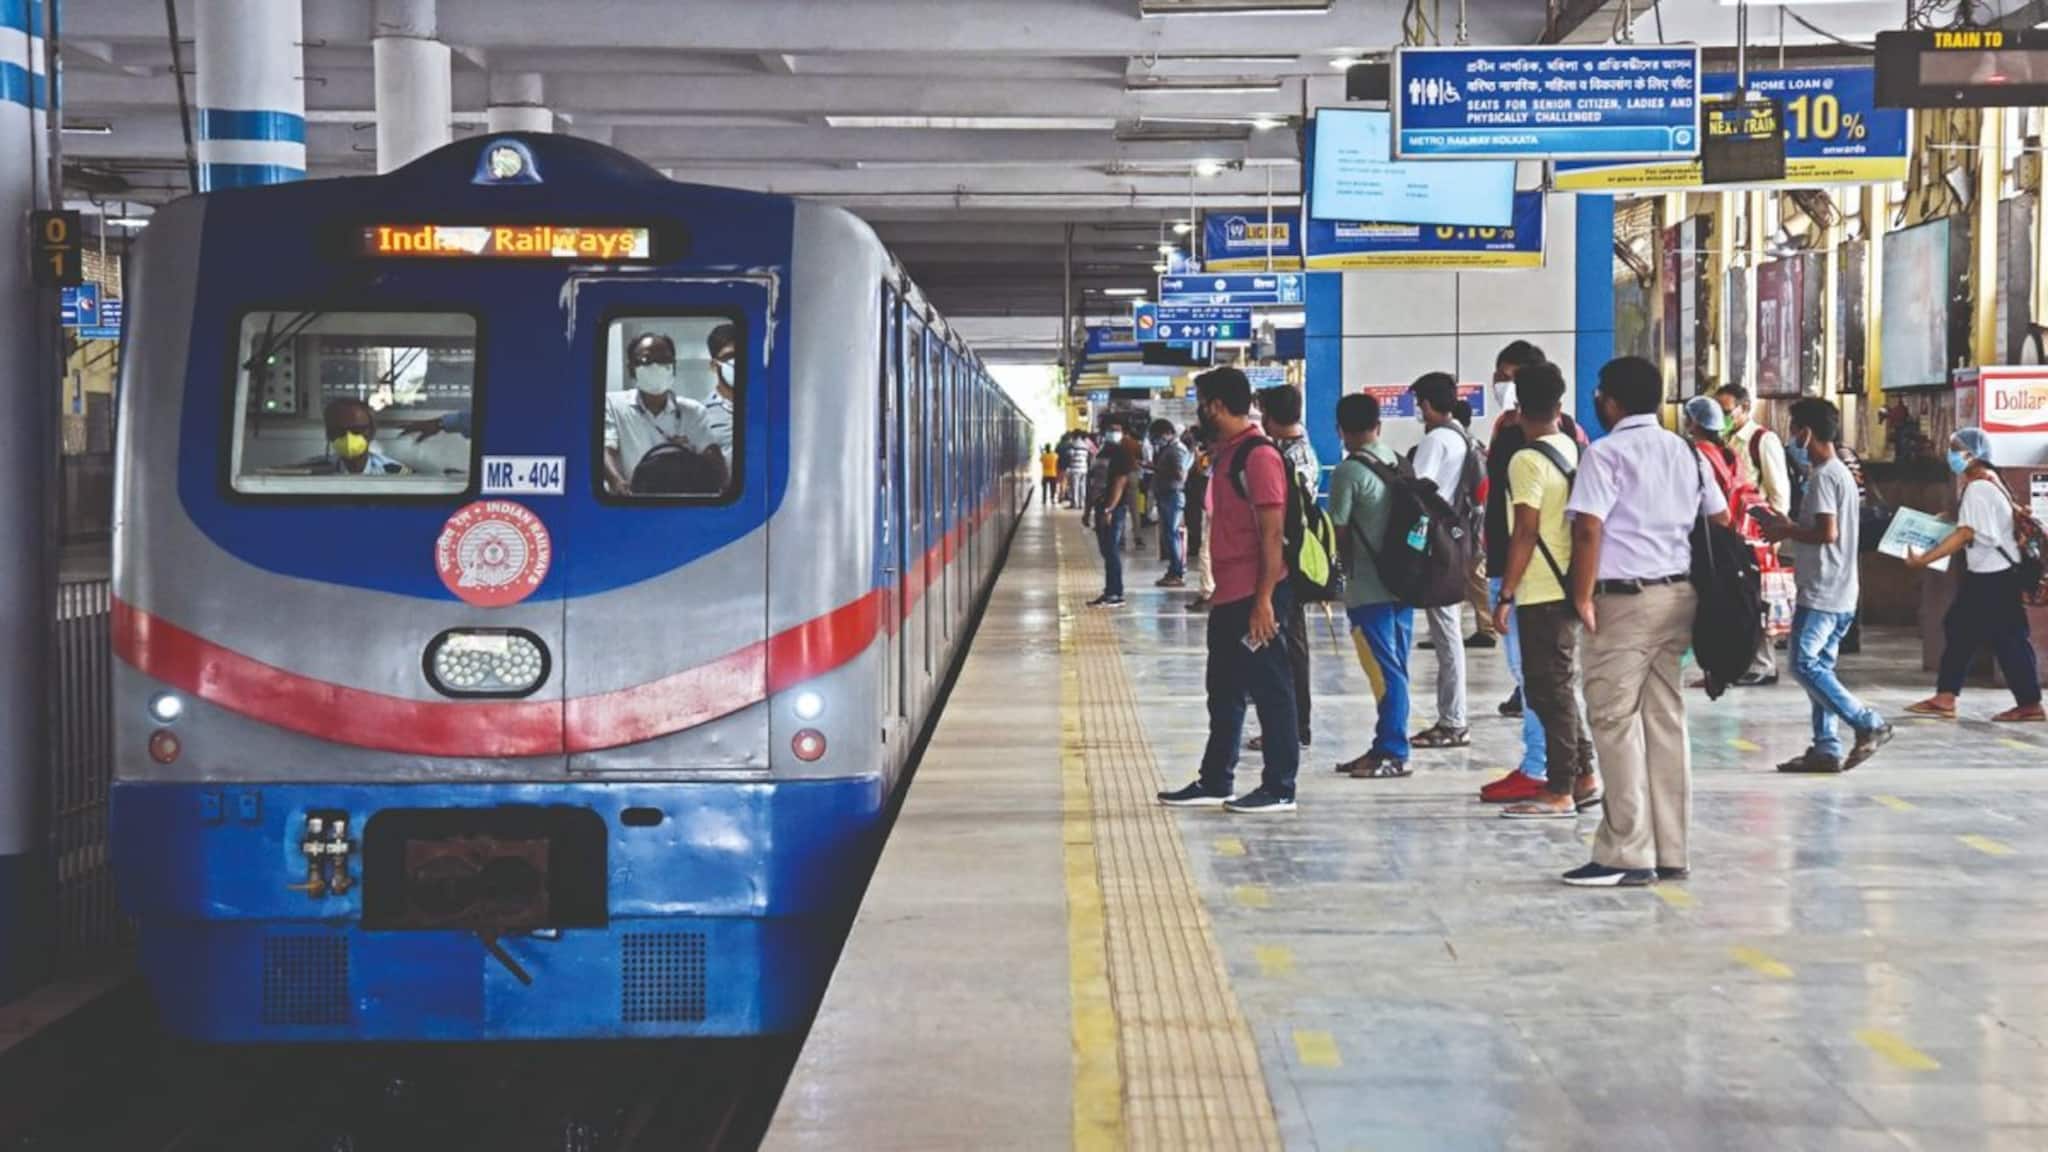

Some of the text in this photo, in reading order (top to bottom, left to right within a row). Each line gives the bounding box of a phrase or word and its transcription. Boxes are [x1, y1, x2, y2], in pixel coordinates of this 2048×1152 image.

[1935, 32, 2003, 48] TRAIN TO
[1751, 80, 1785, 90] HOME
[1789, 79, 1820, 89] LOAN
[1467, 99, 1499, 110] SEATS
[1505, 99, 1527, 110] FOR
[1533, 99, 1571, 110] SENIOR
[1627, 97, 1665, 108] LADIES
[1671, 97, 1692, 108] AND
[1467, 112, 1601, 123] PHYSICALLY CHALLENGED
[1709, 120, 1738, 134] NEX
[1409, 136, 1538, 146] METRO RAILWAY KOLKATA
[1823, 145, 1865, 154] onwards
[46, 218, 66, 242] 0
[379, 226, 636, 258] Indi Railways
[1995, 390, 2046, 410] Dollar
[487, 462, 513, 488] MR
[529, 462, 560, 488] 404
[486, 502, 550, 585] INDIAN RAILWAYS
